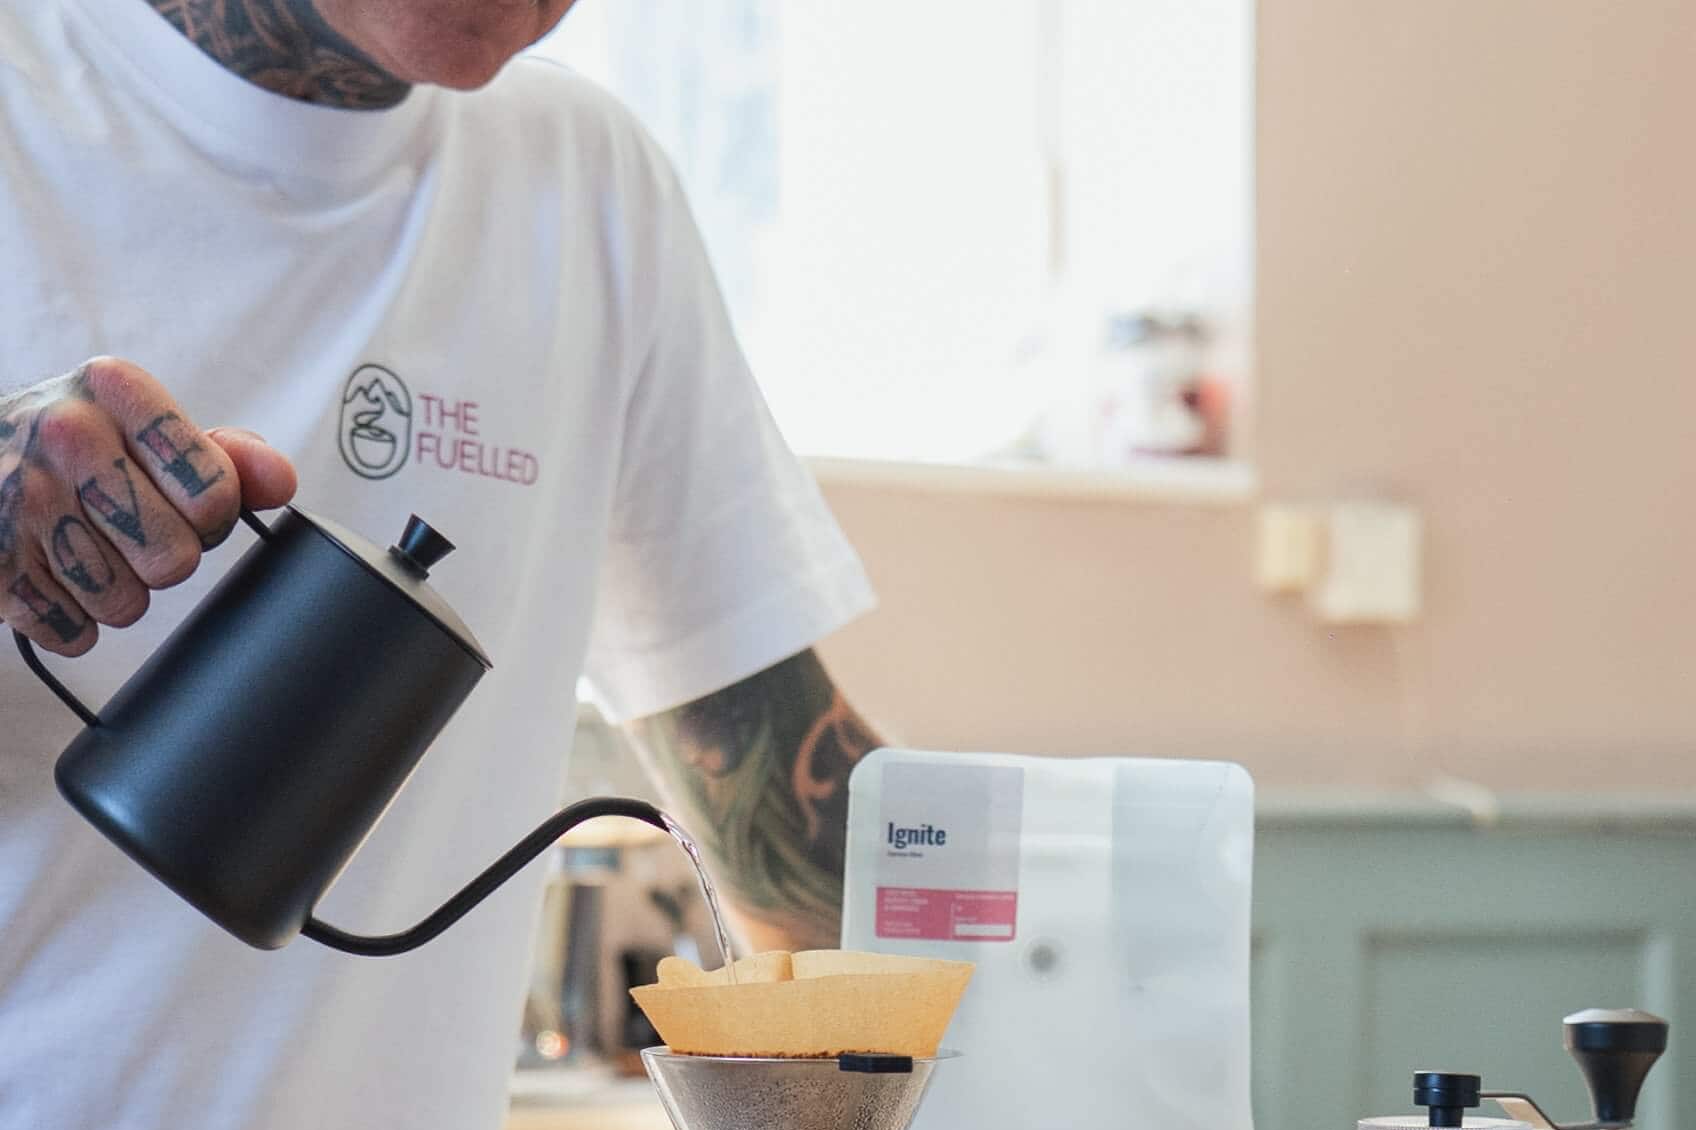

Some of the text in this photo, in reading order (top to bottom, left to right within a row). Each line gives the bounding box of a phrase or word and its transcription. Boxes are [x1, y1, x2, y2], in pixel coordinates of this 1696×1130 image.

[418, 394, 480, 436] THE
[416, 432, 539, 486] FUELLED
[888, 822, 946, 849] Ignite
